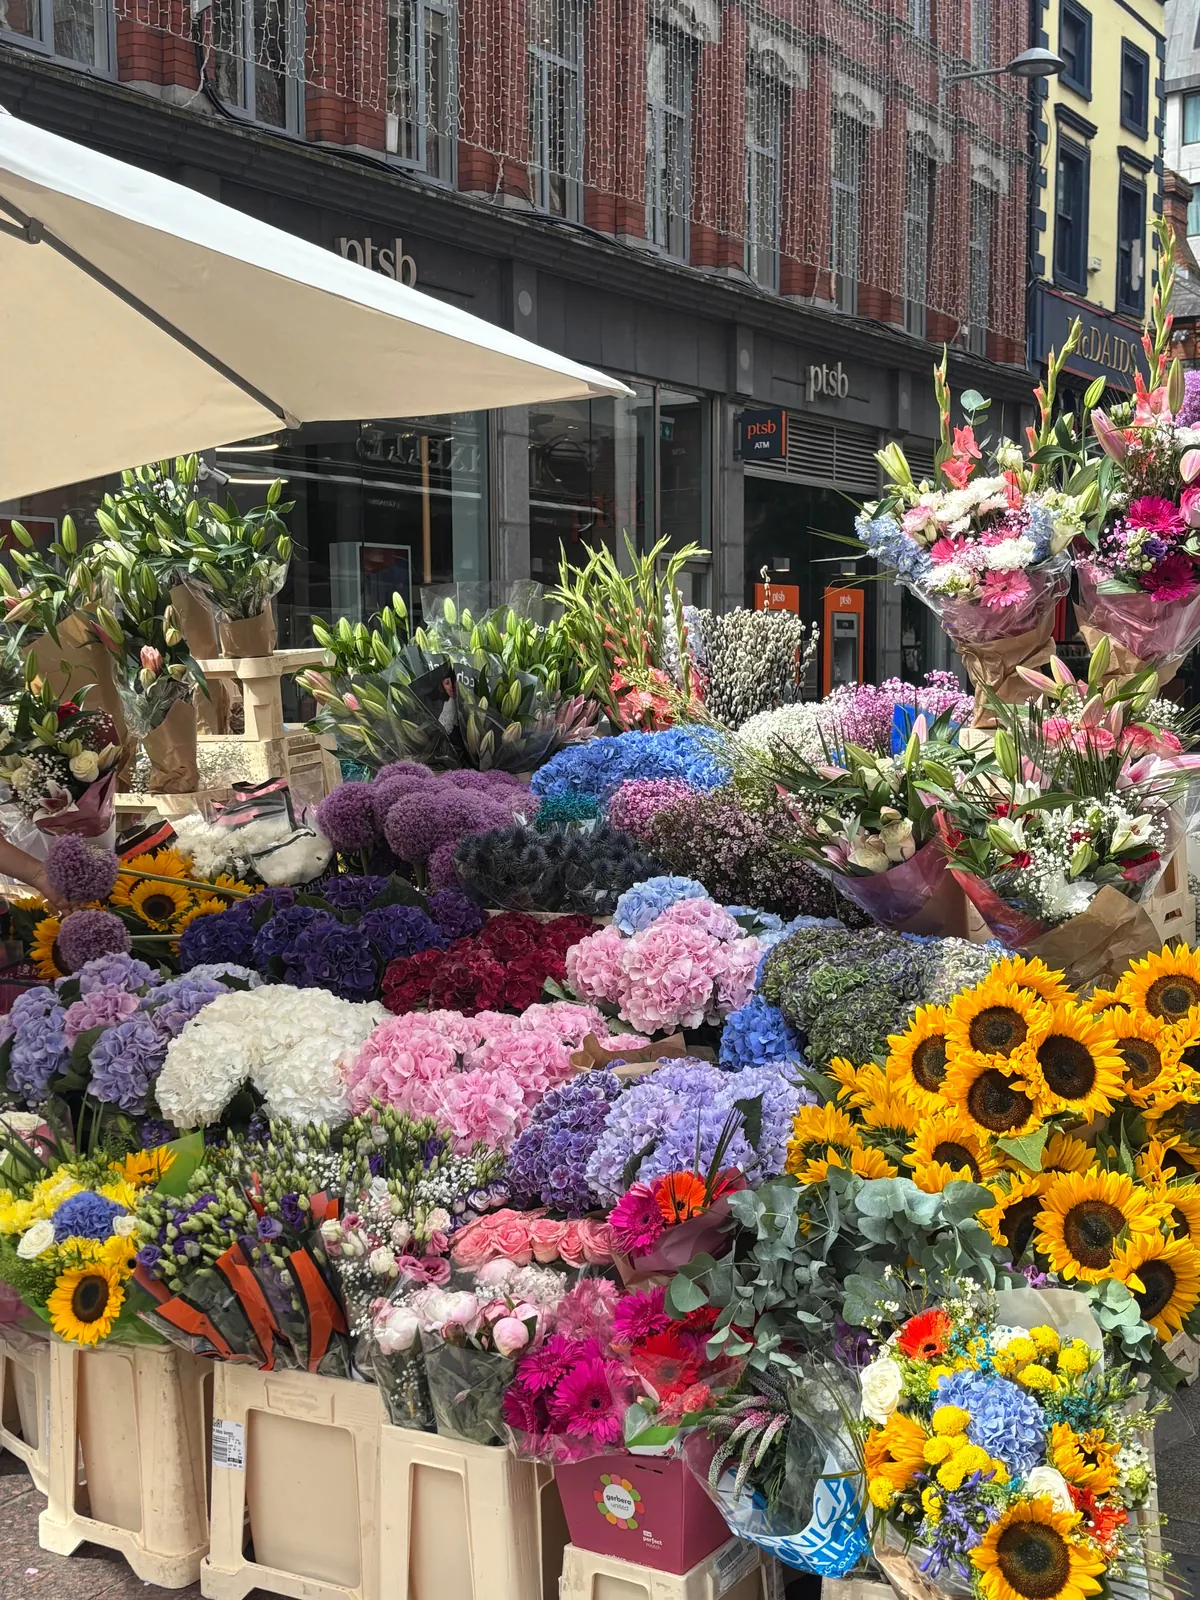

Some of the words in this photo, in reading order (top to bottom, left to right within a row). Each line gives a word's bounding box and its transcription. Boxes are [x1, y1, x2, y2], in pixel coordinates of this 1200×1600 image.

[807, 361, 849, 402] ptsb
[747, 419, 777, 440] ptsb
[753, 441, 770, 450] ATM
[772, 591, 786, 605] ptsb
[840, 594, 852, 607] ptsb
[606, 1494, 632, 1505] gerbera
[611, 1502, 629, 1512] united
[642, 1536, 663, 1546] perfect
